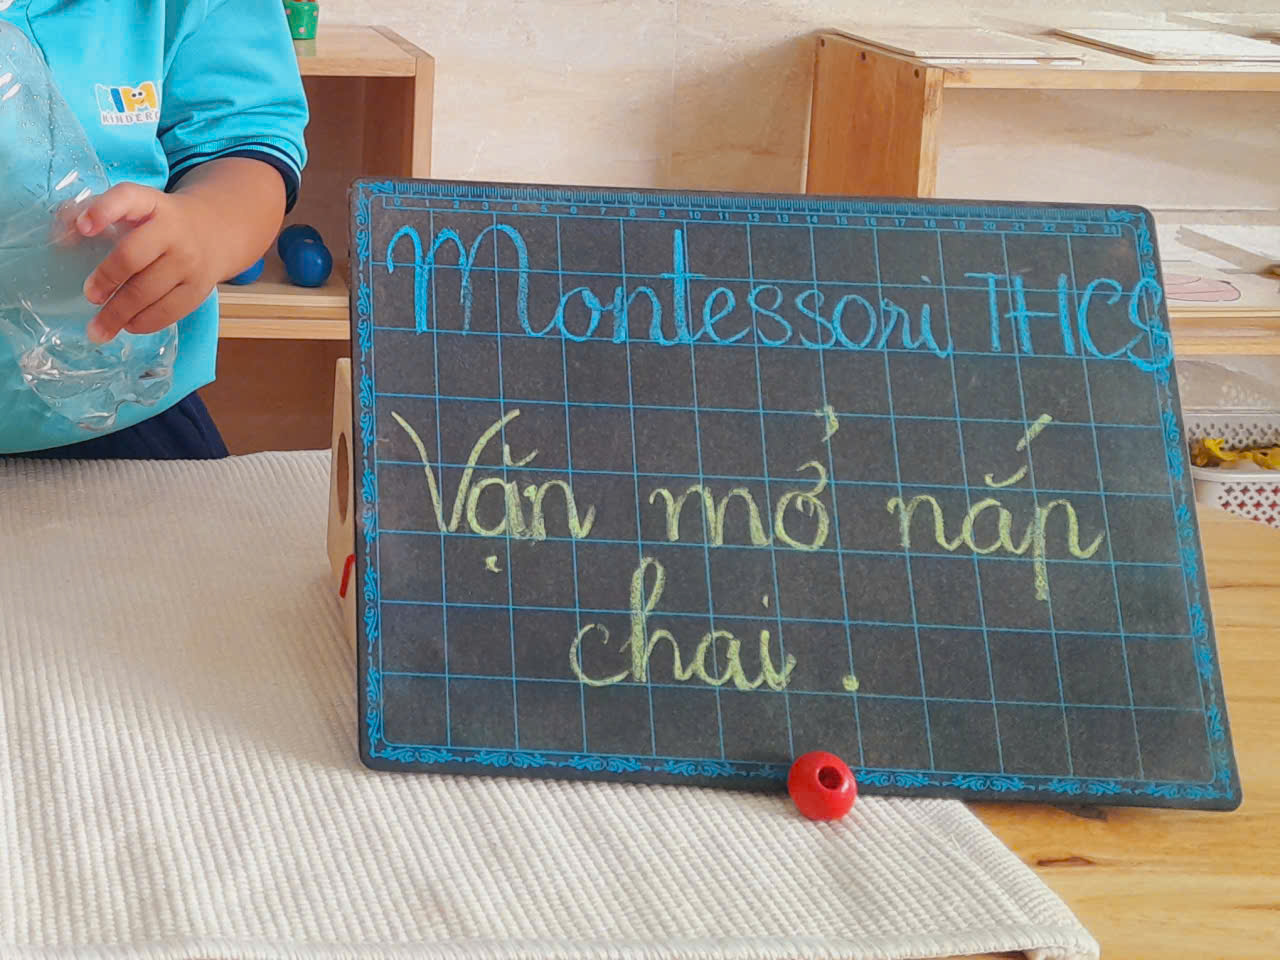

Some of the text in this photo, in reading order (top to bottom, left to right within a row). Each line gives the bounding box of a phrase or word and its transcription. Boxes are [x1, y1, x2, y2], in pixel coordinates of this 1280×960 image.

[425, 199, 431, 207] 1
[481, 201, 489, 210] 3
[511, 203, 519, 211] 4
[600, 207, 607, 215] 7
[688, 211, 701, 219] 10
[718, 212, 730, 221] 11
[747, 213, 760, 222] 12
[386, 223, 1175, 372] Montessori THCS
[391, 404, 1106, 602] Vặn mở nắp
